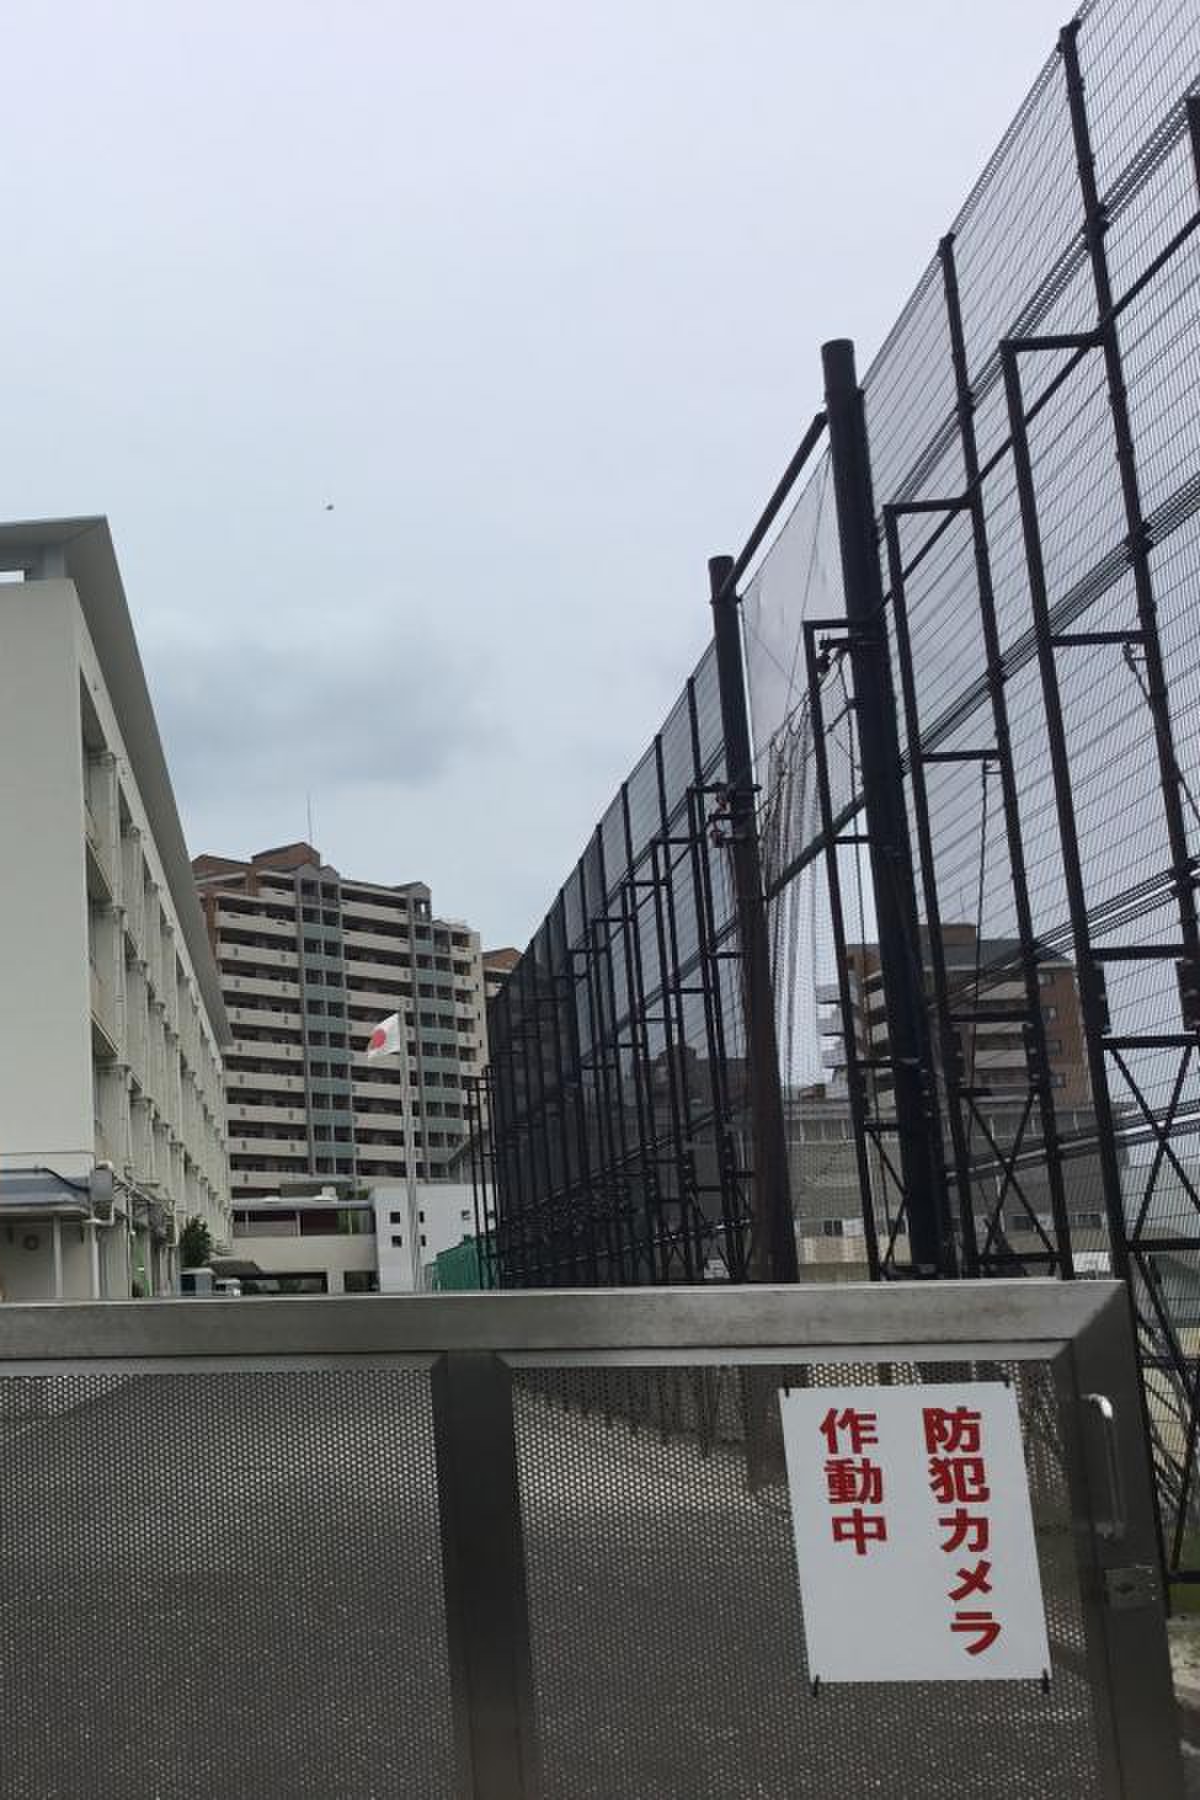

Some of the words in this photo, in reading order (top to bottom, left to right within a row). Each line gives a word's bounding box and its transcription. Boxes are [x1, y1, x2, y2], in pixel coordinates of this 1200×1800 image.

[819, 1407, 887, 1556] 作動中
[921, 1405, 1001, 1655] 防犯カメラ
